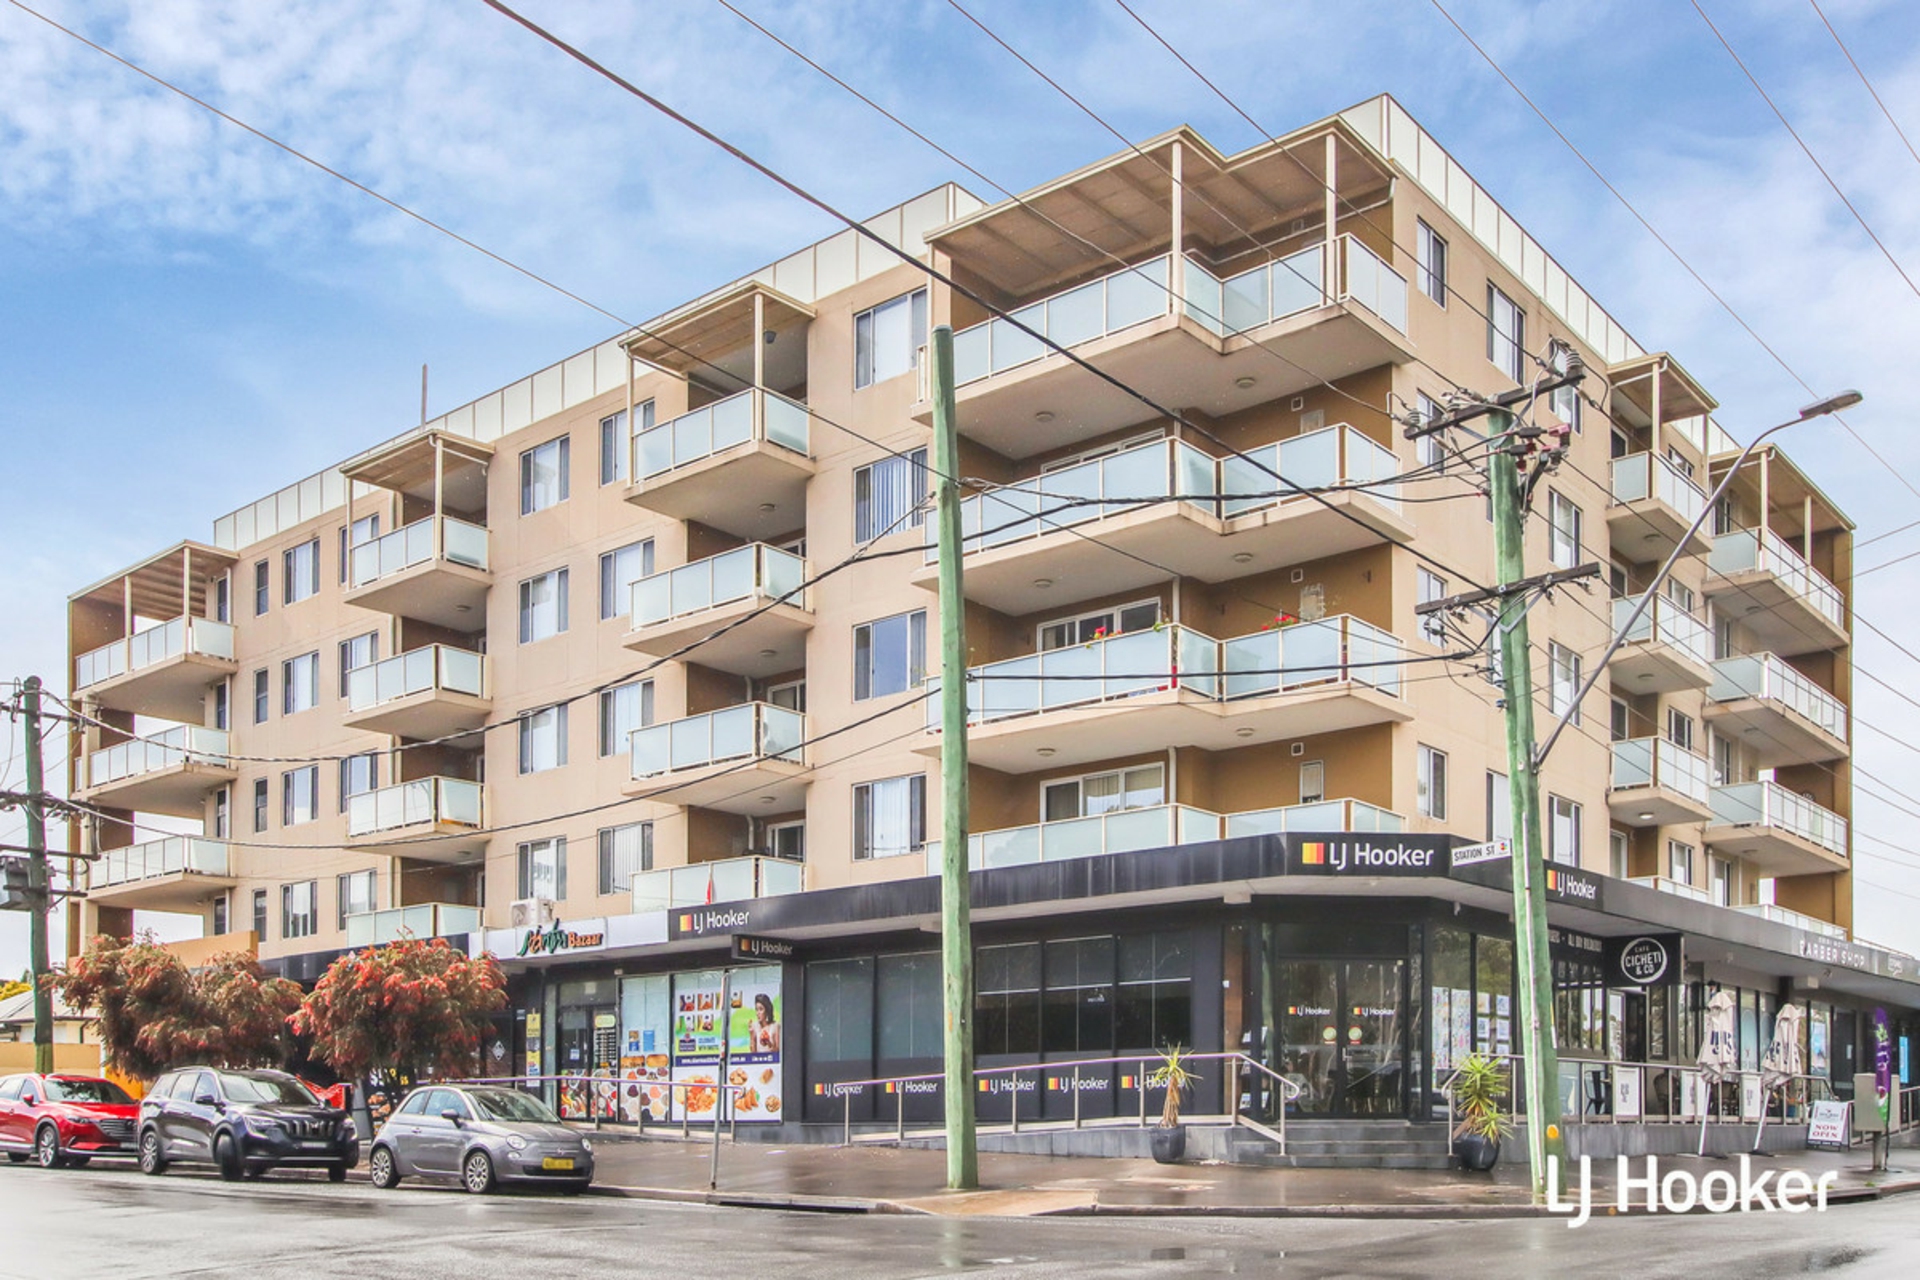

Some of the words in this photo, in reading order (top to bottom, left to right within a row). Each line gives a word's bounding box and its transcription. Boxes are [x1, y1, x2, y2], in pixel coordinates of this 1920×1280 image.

[1329, 842, 1347, 871] LJ
[1354, 842, 1435, 867] Hooker
[1453, 848, 1483, 862] STATION
[1485, 845, 1496, 856] ST
[1557, 872, 1566, 897] LJ
[1566, 874, 1597, 900] Hooker
[693, 913, 704, 934] LJ
[706, 909, 750, 929] Hooker
[568, 931, 604, 948] Bazaar
[751, 940, 760, 955] LJ
[761, 941, 793, 955] Hooker
[1841, 951, 1865, 967] SHOP
[1305, 1006, 1331, 1016] Hooker
[1369, 1007, 1396, 1016] Hooker
[905, 1081, 938, 1093] Hooker
[989, 1079, 999, 1095] LJ
[1060, 1077, 1070, 1094] LJ
